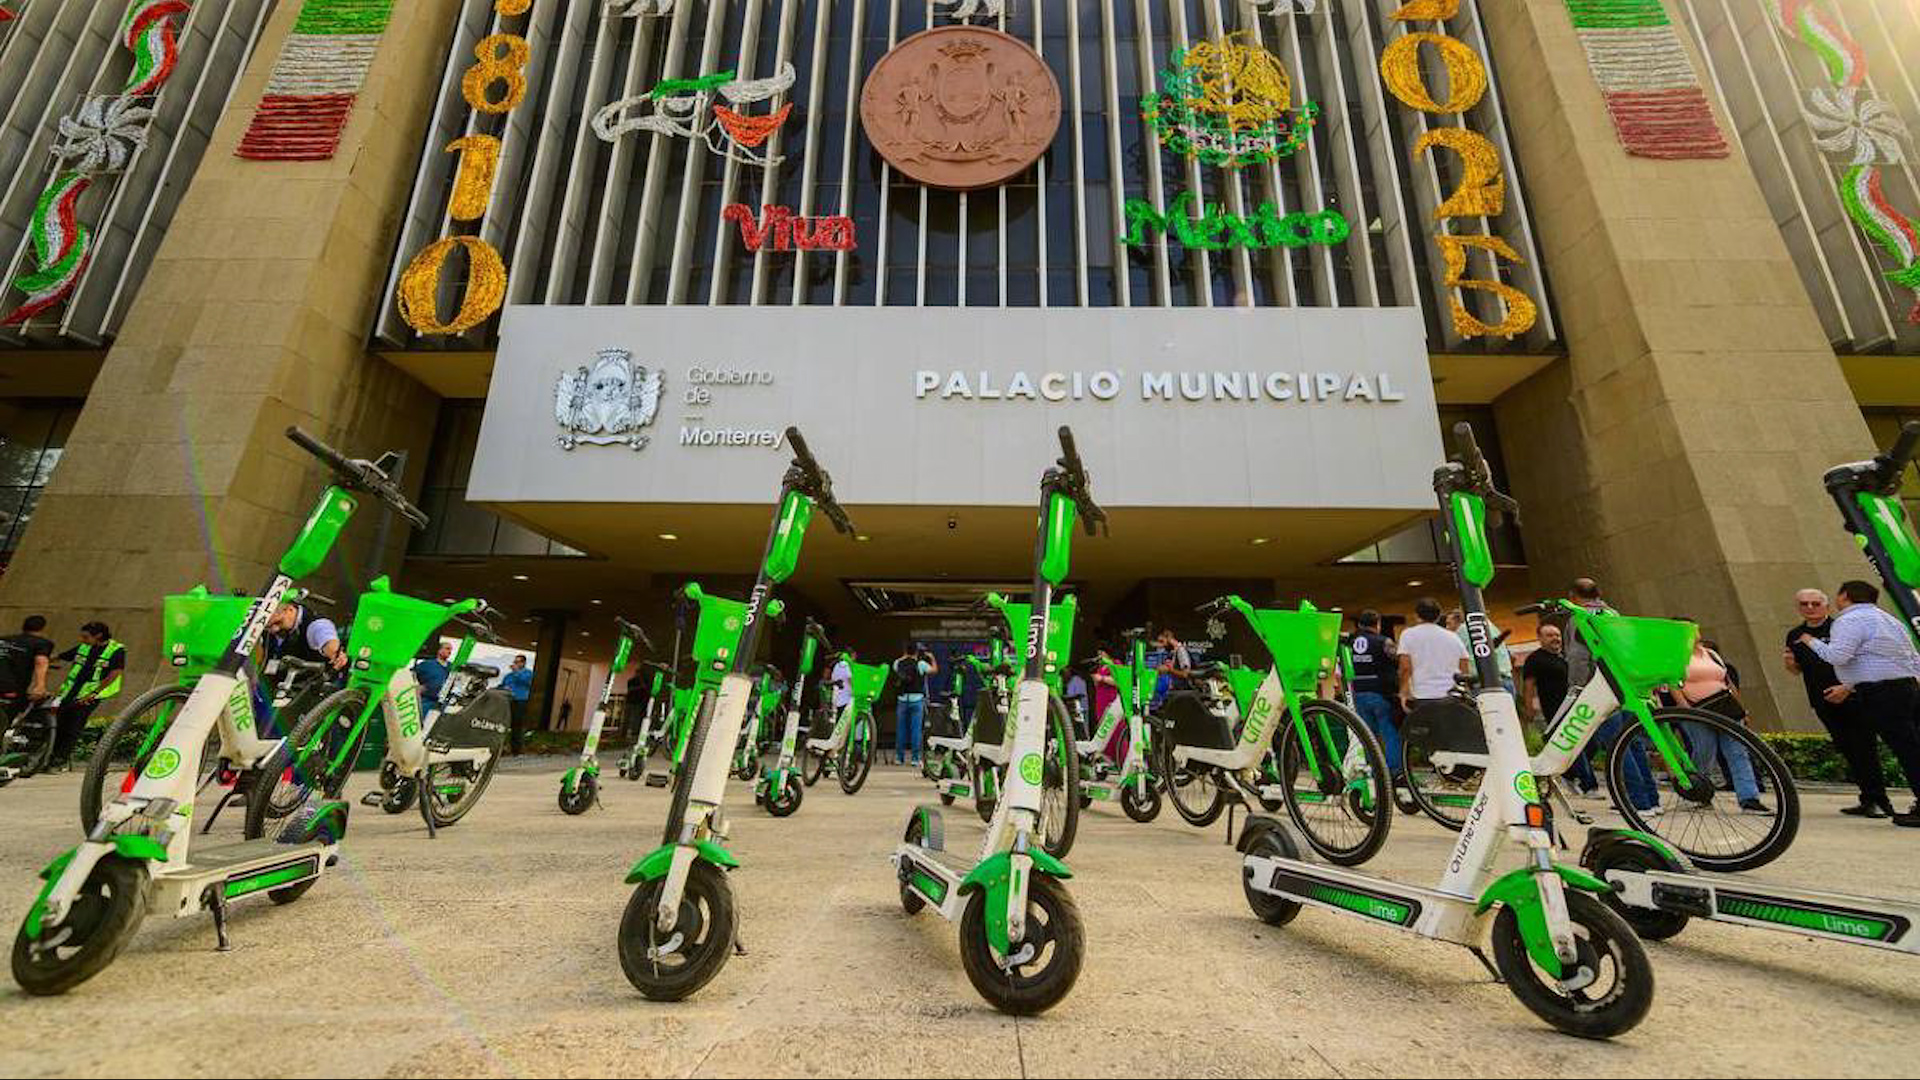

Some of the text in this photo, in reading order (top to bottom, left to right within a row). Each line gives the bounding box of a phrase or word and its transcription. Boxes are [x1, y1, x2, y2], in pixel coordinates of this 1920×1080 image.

[397, 0, 531, 334] 810
[1380, 0, 1537, 336] 025
[723, 203, 857, 251] Viva
[684, 387, 710, 406] de
[688, 364, 773, 386] Gobierno
[915, 370, 1405, 403] PALACIO MUNICIPAL
[680, 427, 784, 450] Monterrey
[1466, 612, 1491, 657] Lime
[394, 684, 420, 738] Lime
[1242, 696, 1272, 743] Lime
[1550, 703, 1596, 751] Lime
[1822, 913, 1871, 936] Lime
